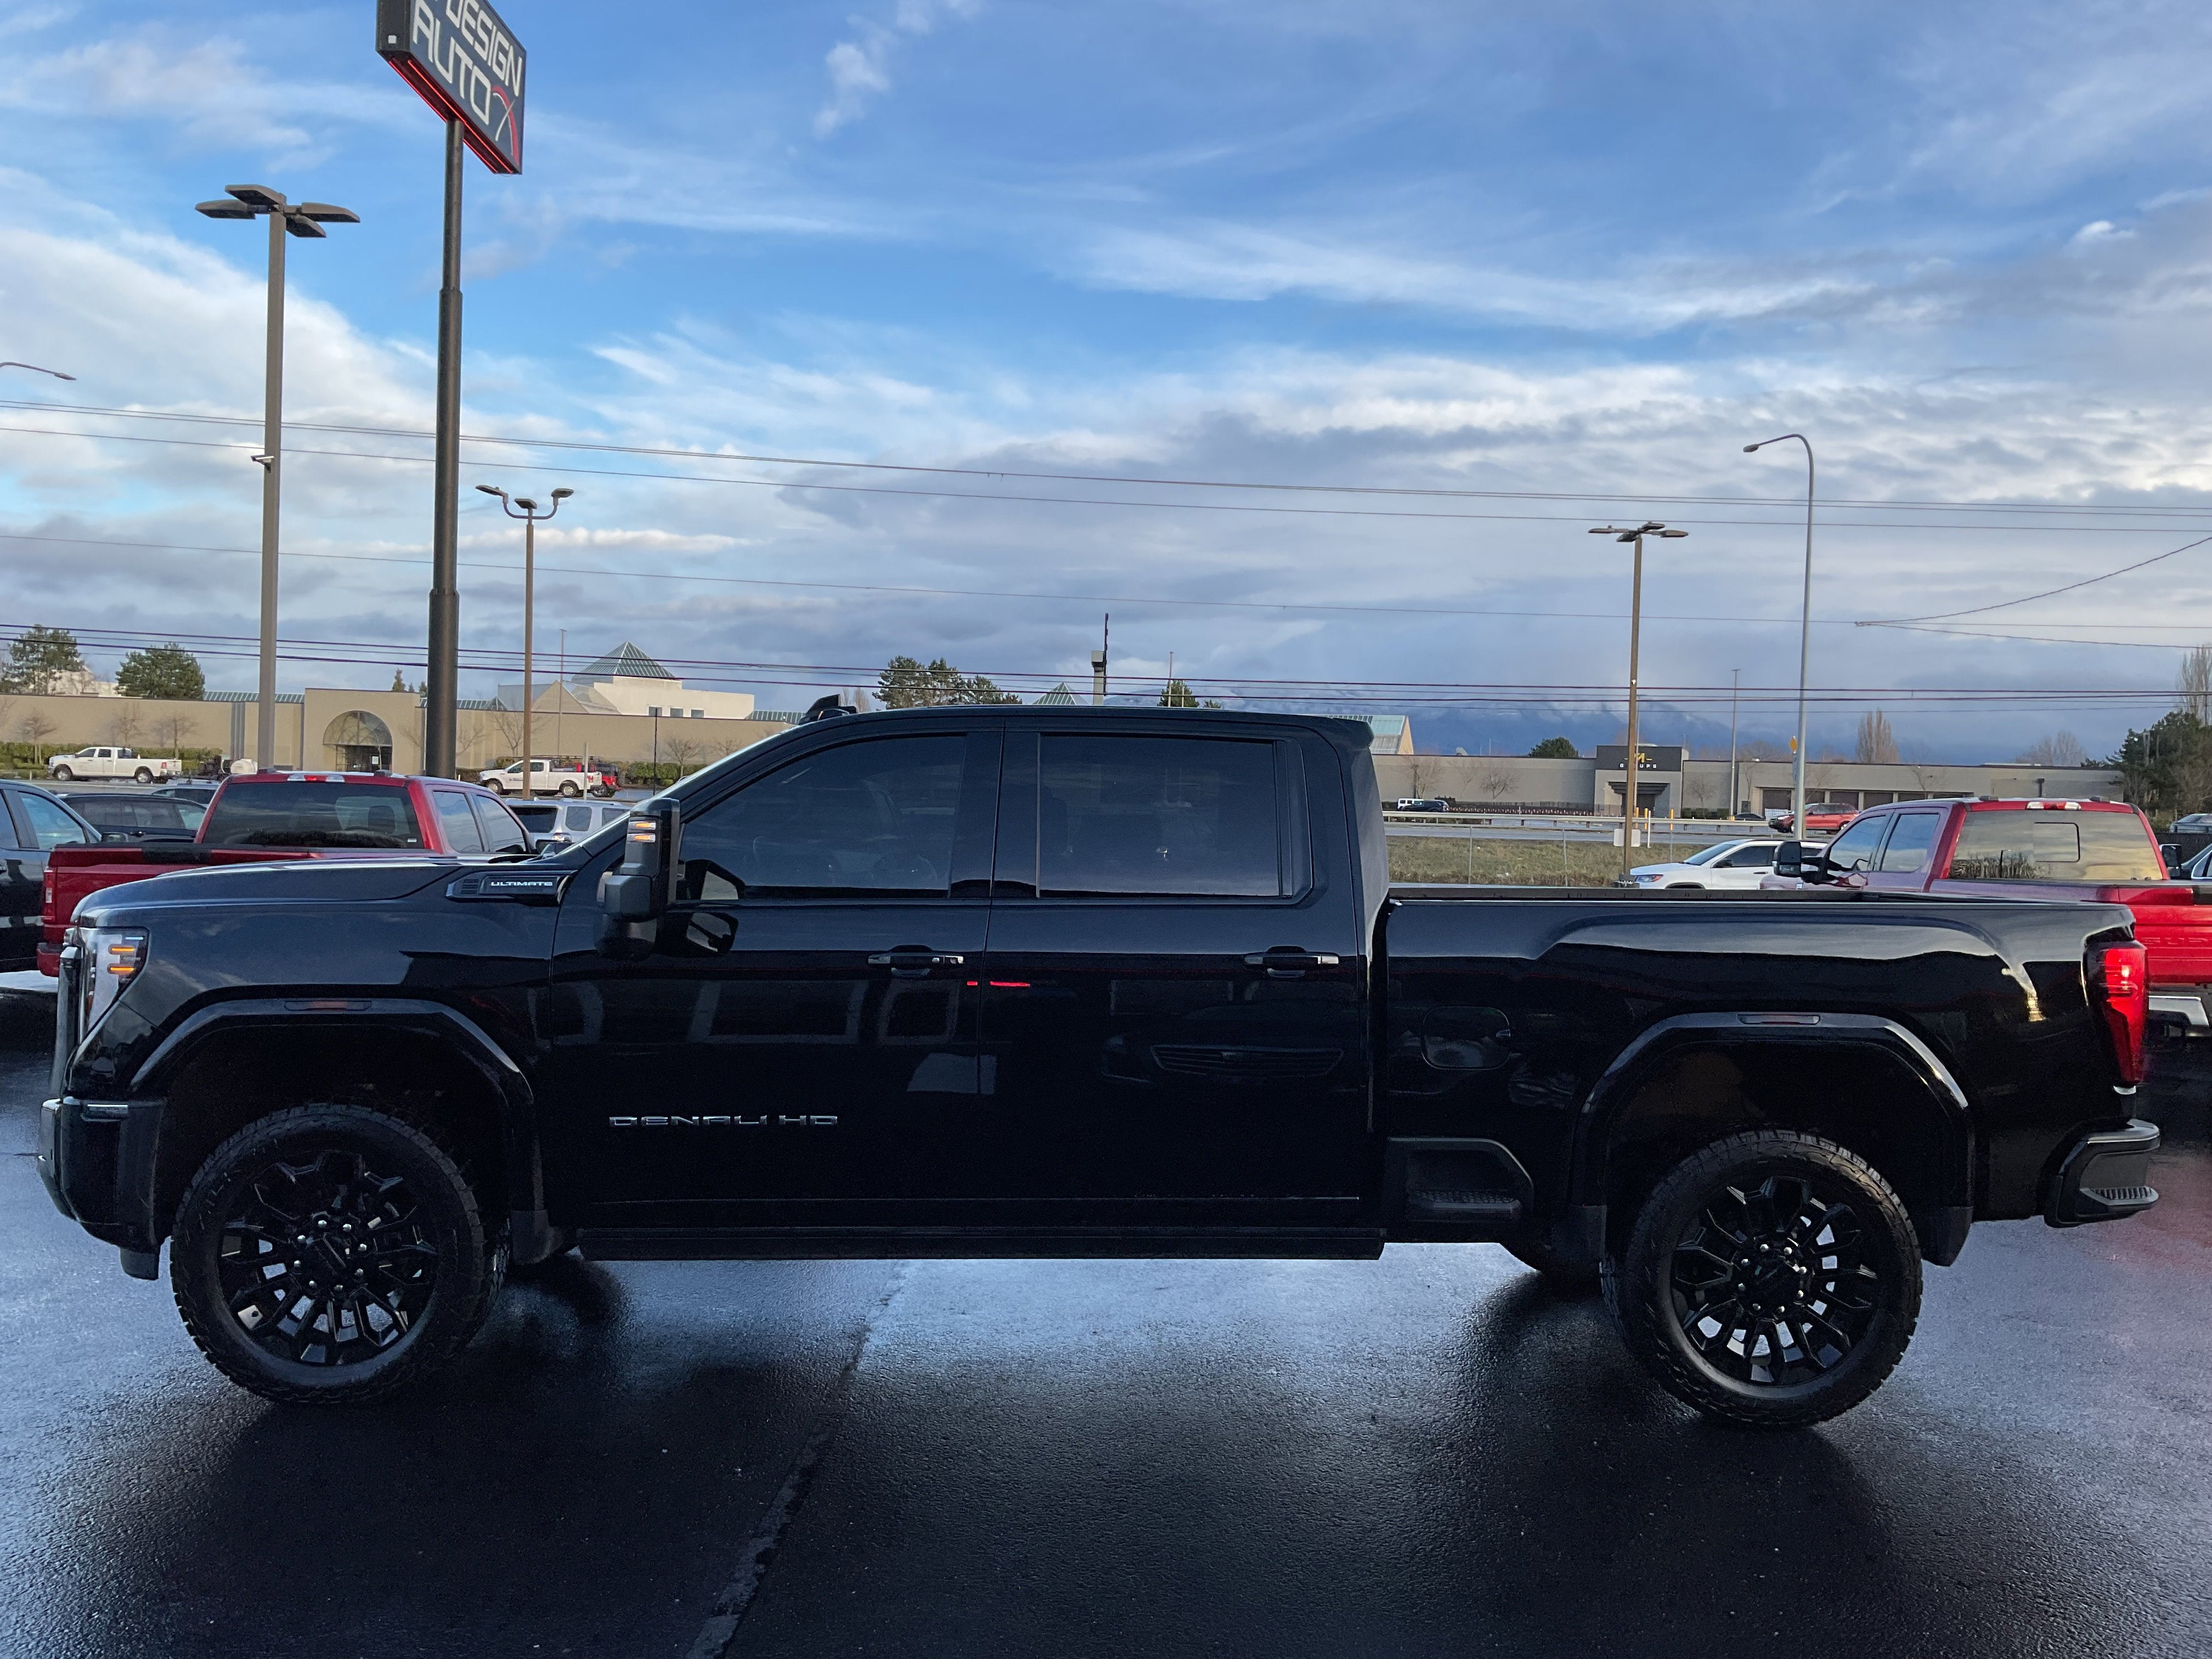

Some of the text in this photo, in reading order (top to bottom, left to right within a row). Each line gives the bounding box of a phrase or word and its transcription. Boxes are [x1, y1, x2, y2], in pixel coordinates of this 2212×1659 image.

[446, 0, 523, 97] DESIGN
[609, 1115, 838, 1126] DENALI HD
